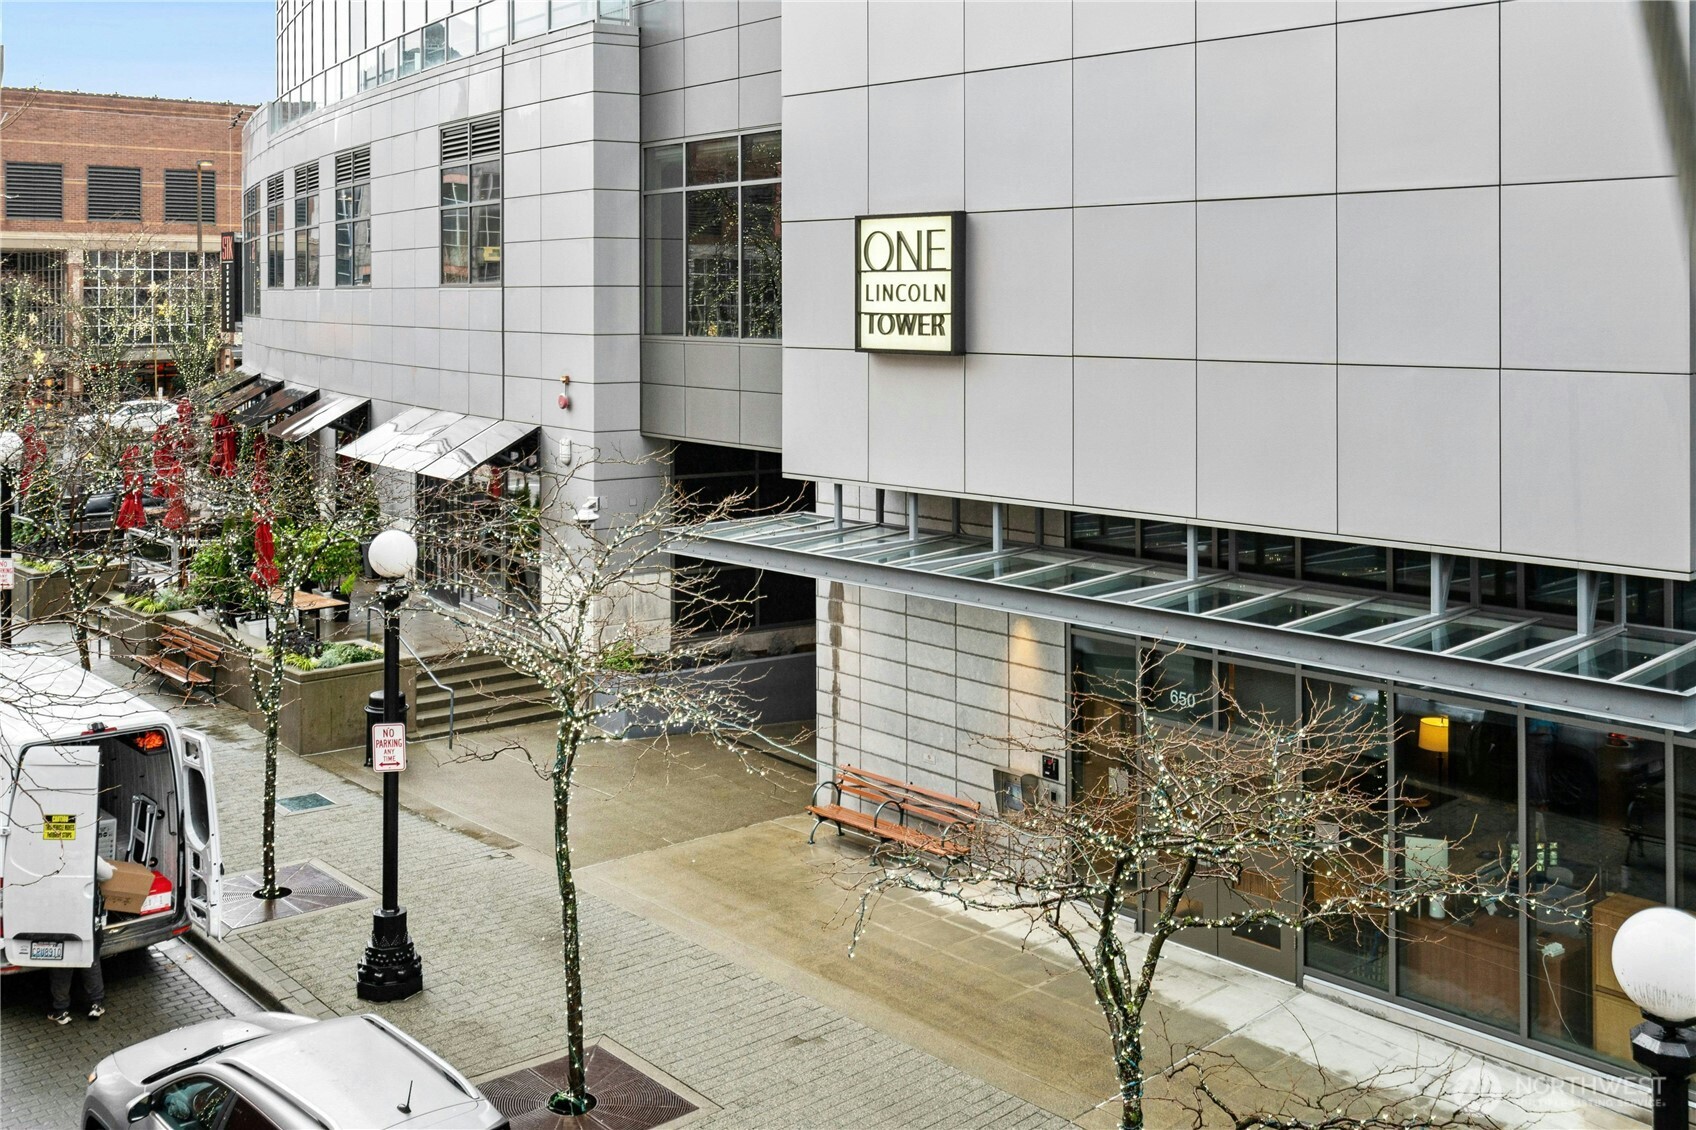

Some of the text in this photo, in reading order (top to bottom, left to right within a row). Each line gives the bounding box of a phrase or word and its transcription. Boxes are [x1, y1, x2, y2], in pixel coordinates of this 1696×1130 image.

[222, 236, 234, 260] STK
[864, 229, 946, 271] ONE
[865, 283, 946, 302] LINCOLN
[864, 313, 946, 336] TOWER
[1170, 689, 1196, 708] 650
[383, 728, 395, 738] NO
[376, 739, 403, 748] PARKING
